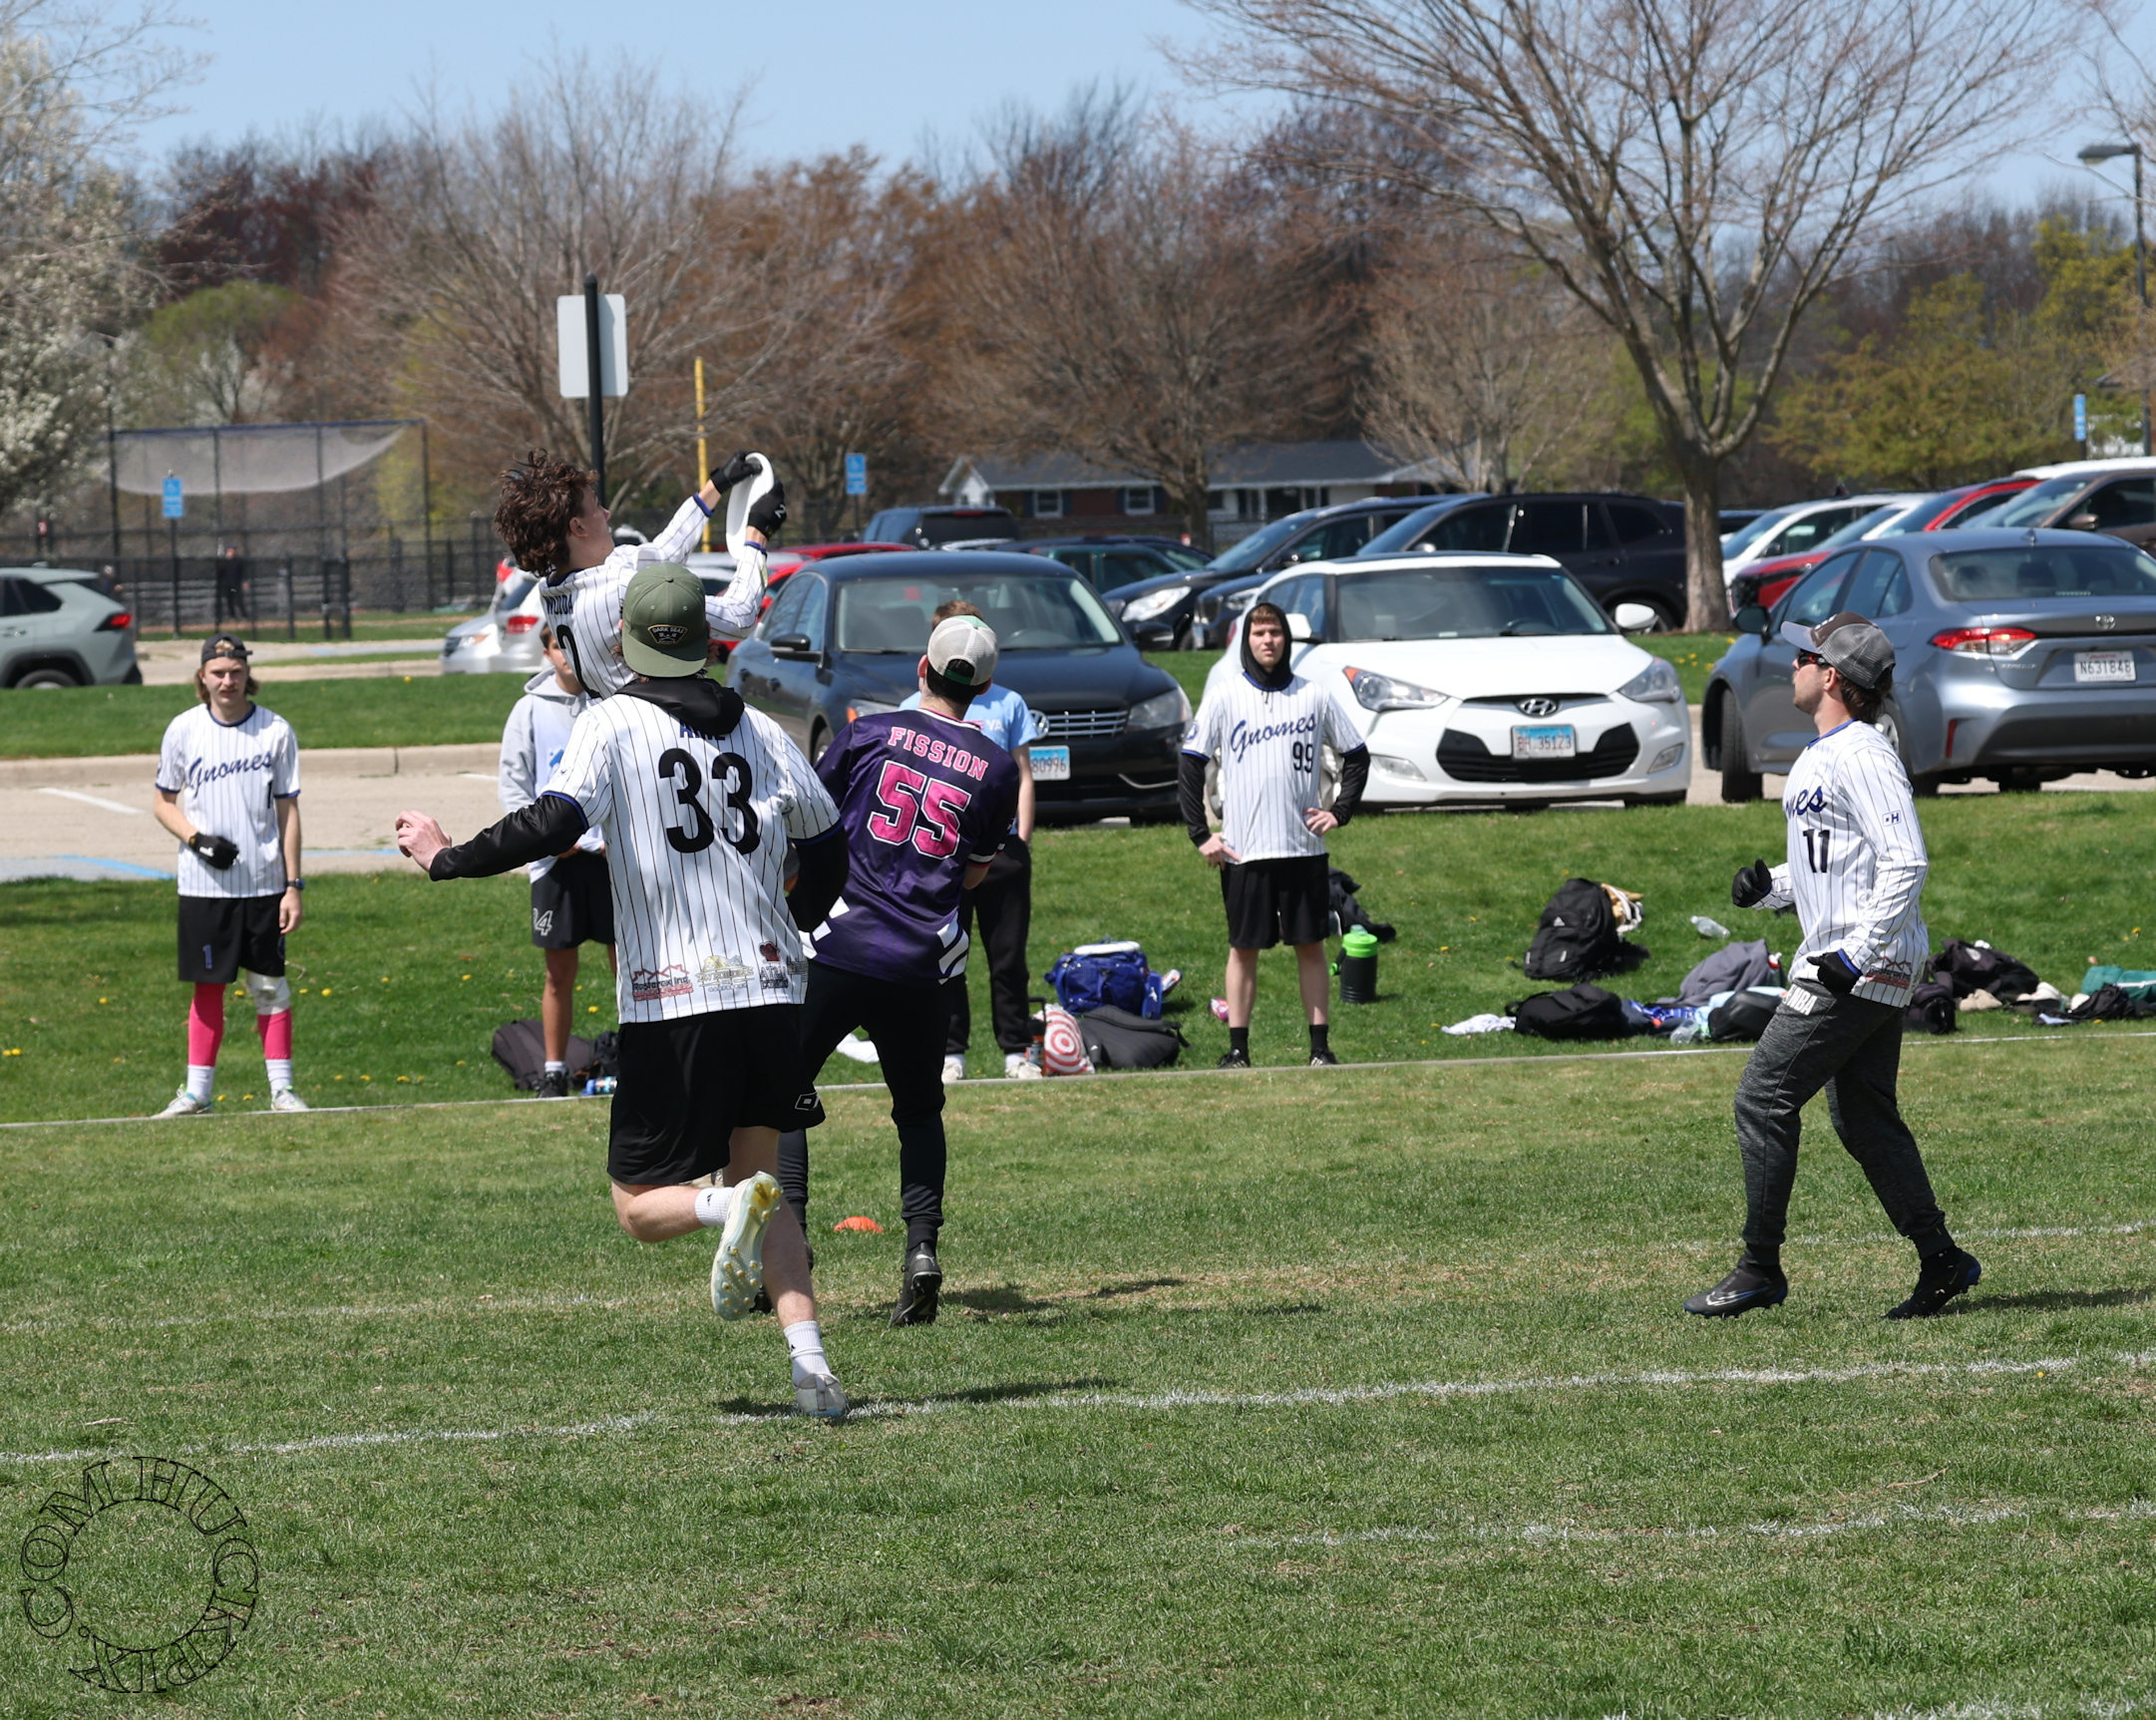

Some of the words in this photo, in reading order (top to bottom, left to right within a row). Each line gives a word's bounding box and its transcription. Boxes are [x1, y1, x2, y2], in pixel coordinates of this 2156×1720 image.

[888, 726, 988, 781] FISSION
[1230, 713, 1316, 764] Gnomes
[1292, 741, 1314, 773] 99
[186, 751, 272, 799] Gnomes
[658, 748, 761, 856] 33
[867, 760, 972, 860] 55
[1803, 829, 1831, 873] 11
[202, 944, 212, 970] 1
[1787, 987, 1818, 1016] NBA
